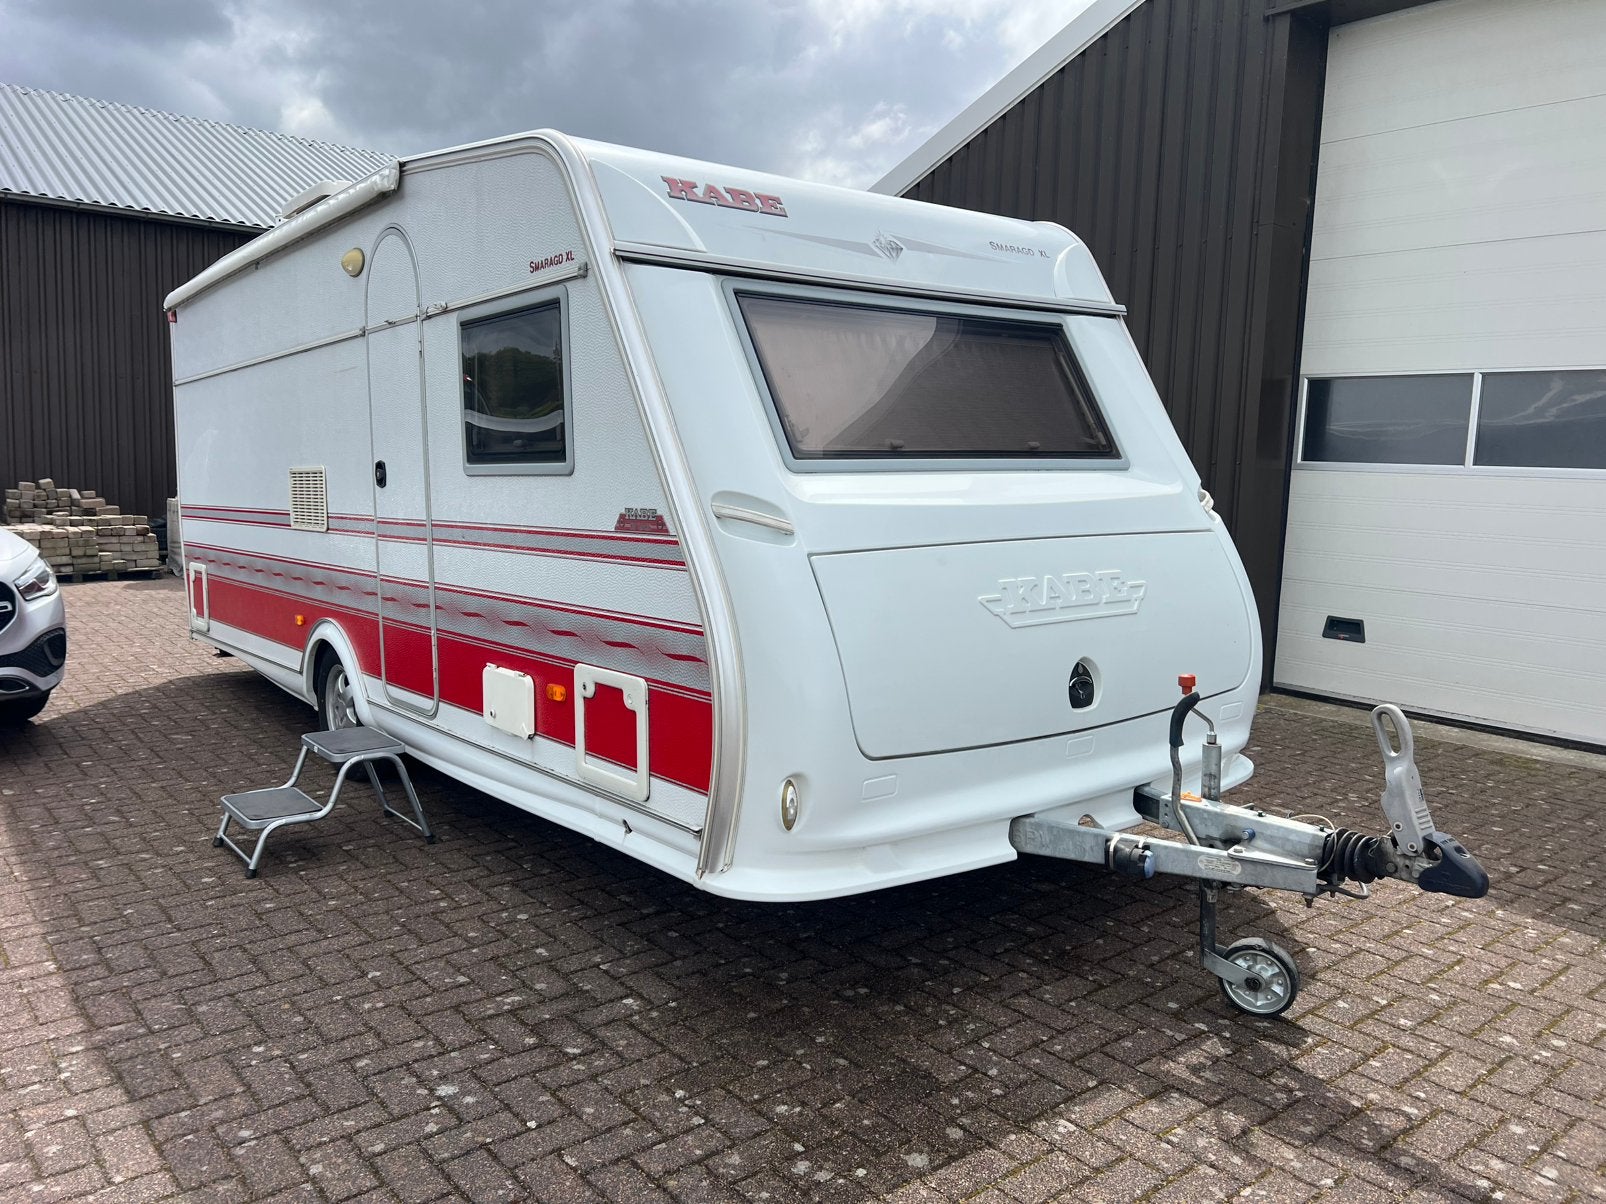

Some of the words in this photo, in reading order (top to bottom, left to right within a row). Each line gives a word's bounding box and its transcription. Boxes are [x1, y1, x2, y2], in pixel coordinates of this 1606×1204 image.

[660, 175, 788, 218] KABE
[565, 250, 575, 262] XL
[1038, 249, 1051, 259] XL
[624, 507, 658, 521] KABE
[995, 569, 1128, 614] KABE
